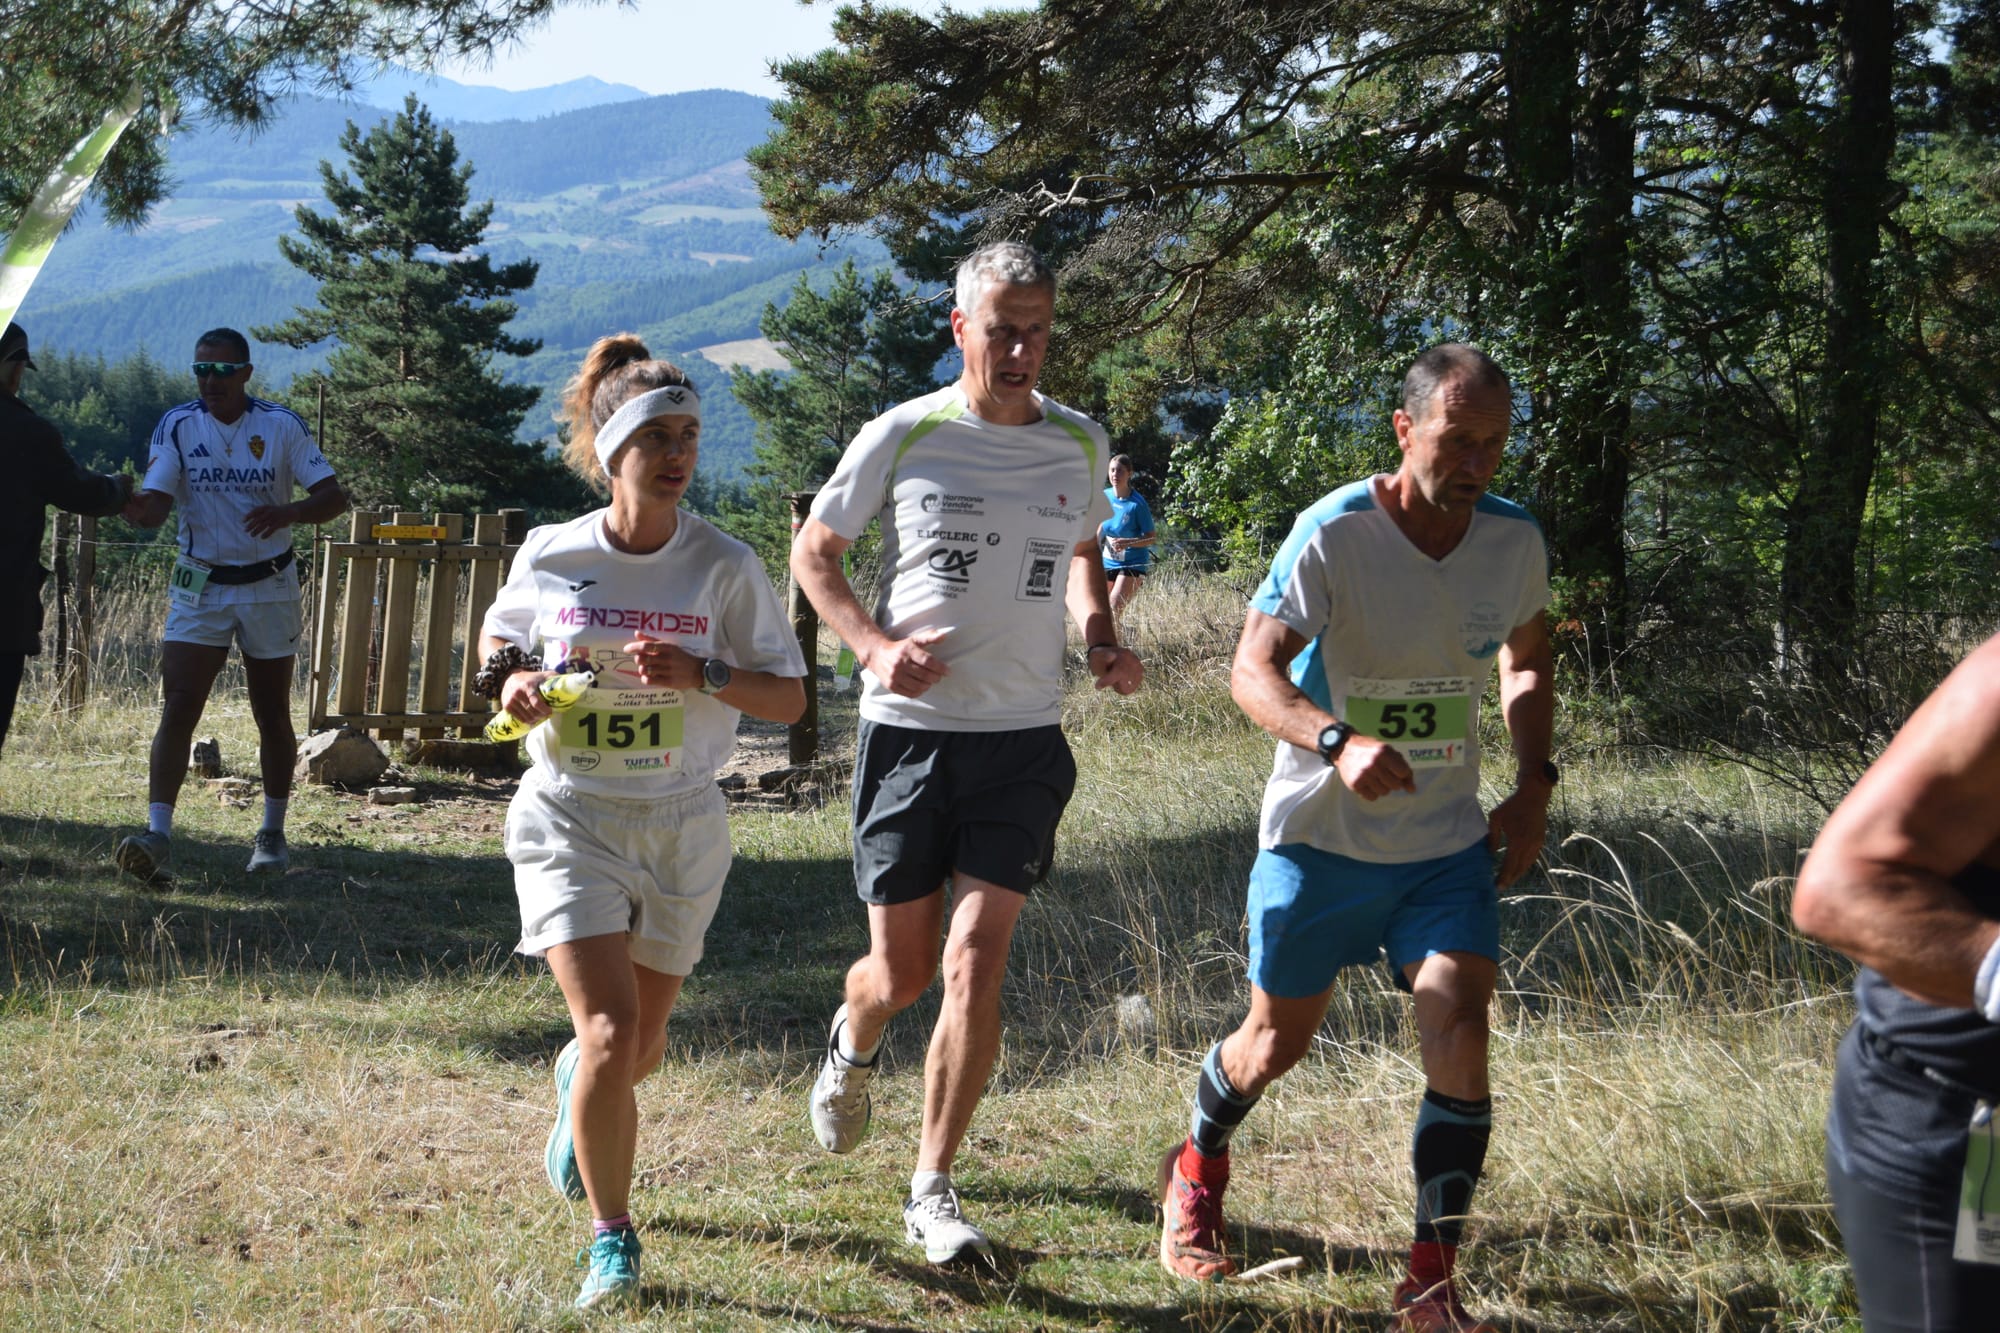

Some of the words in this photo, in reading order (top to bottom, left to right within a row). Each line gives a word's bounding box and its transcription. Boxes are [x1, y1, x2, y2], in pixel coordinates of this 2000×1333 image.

[188, 467, 276, 483] CARAVAN
[175, 567, 193, 589] 10
[555, 607, 708, 635] MENDEKIDEN
[578, 712, 660, 748] 151
[1378, 702, 1437, 739] 53
[571, 755, 597, 764] BFP
